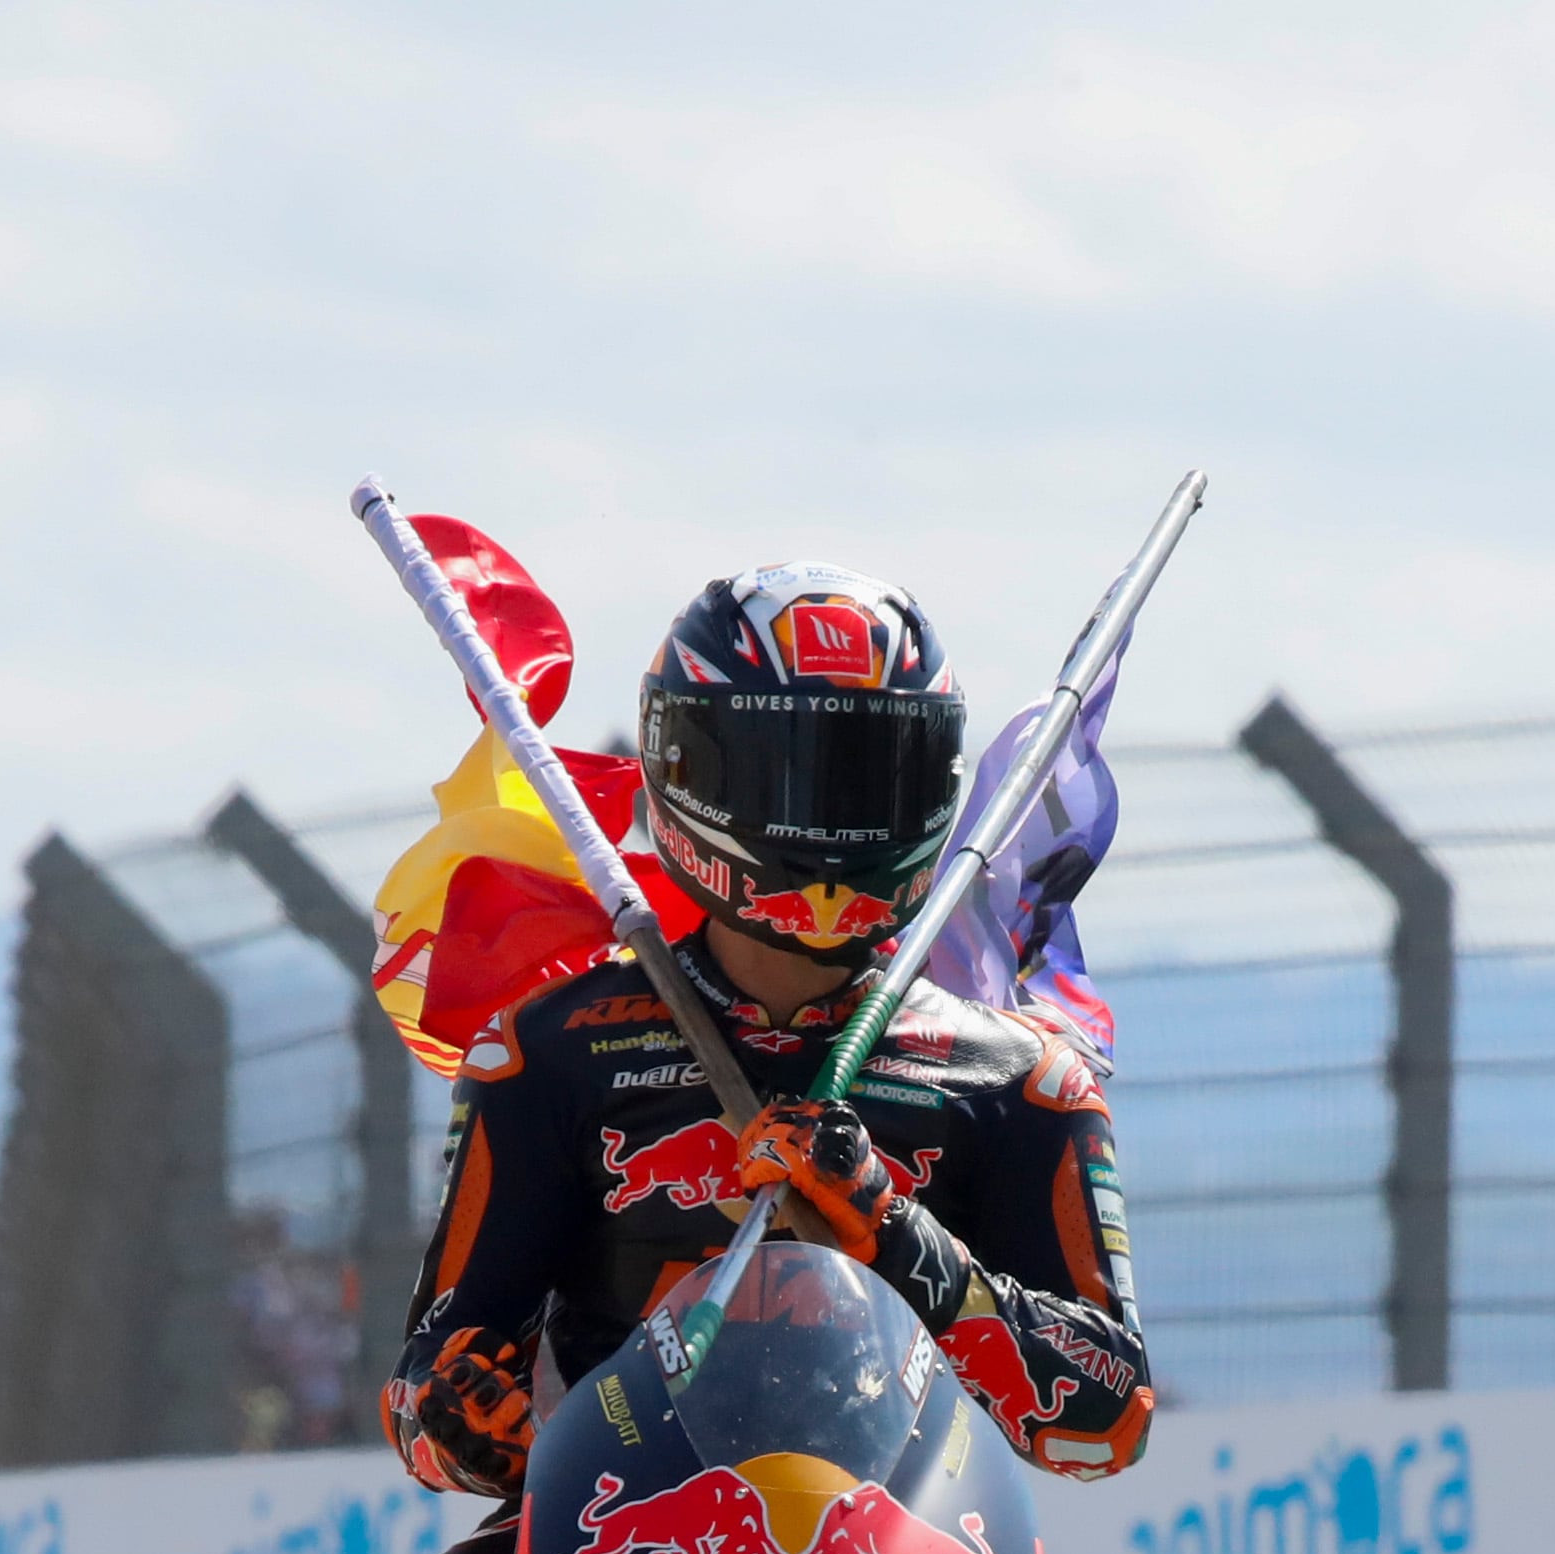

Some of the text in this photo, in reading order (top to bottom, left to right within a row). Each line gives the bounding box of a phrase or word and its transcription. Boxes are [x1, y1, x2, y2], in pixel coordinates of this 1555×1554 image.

[731, 694, 794, 711] GIVES
[808, 696, 855, 713] YOU
[867, 698, 929, 717] WINGS
[665, 783, 733, 826] MOTOBLOUZ
[679, 831, 731, 902] Bull
[590, 1031, 672, 1055] Handy
[867, 1082, 938, 1107] MOTOREX
[650, 1307, 692, 1375] WRS
[1028, 1322, 1135, 1398] AVANT
